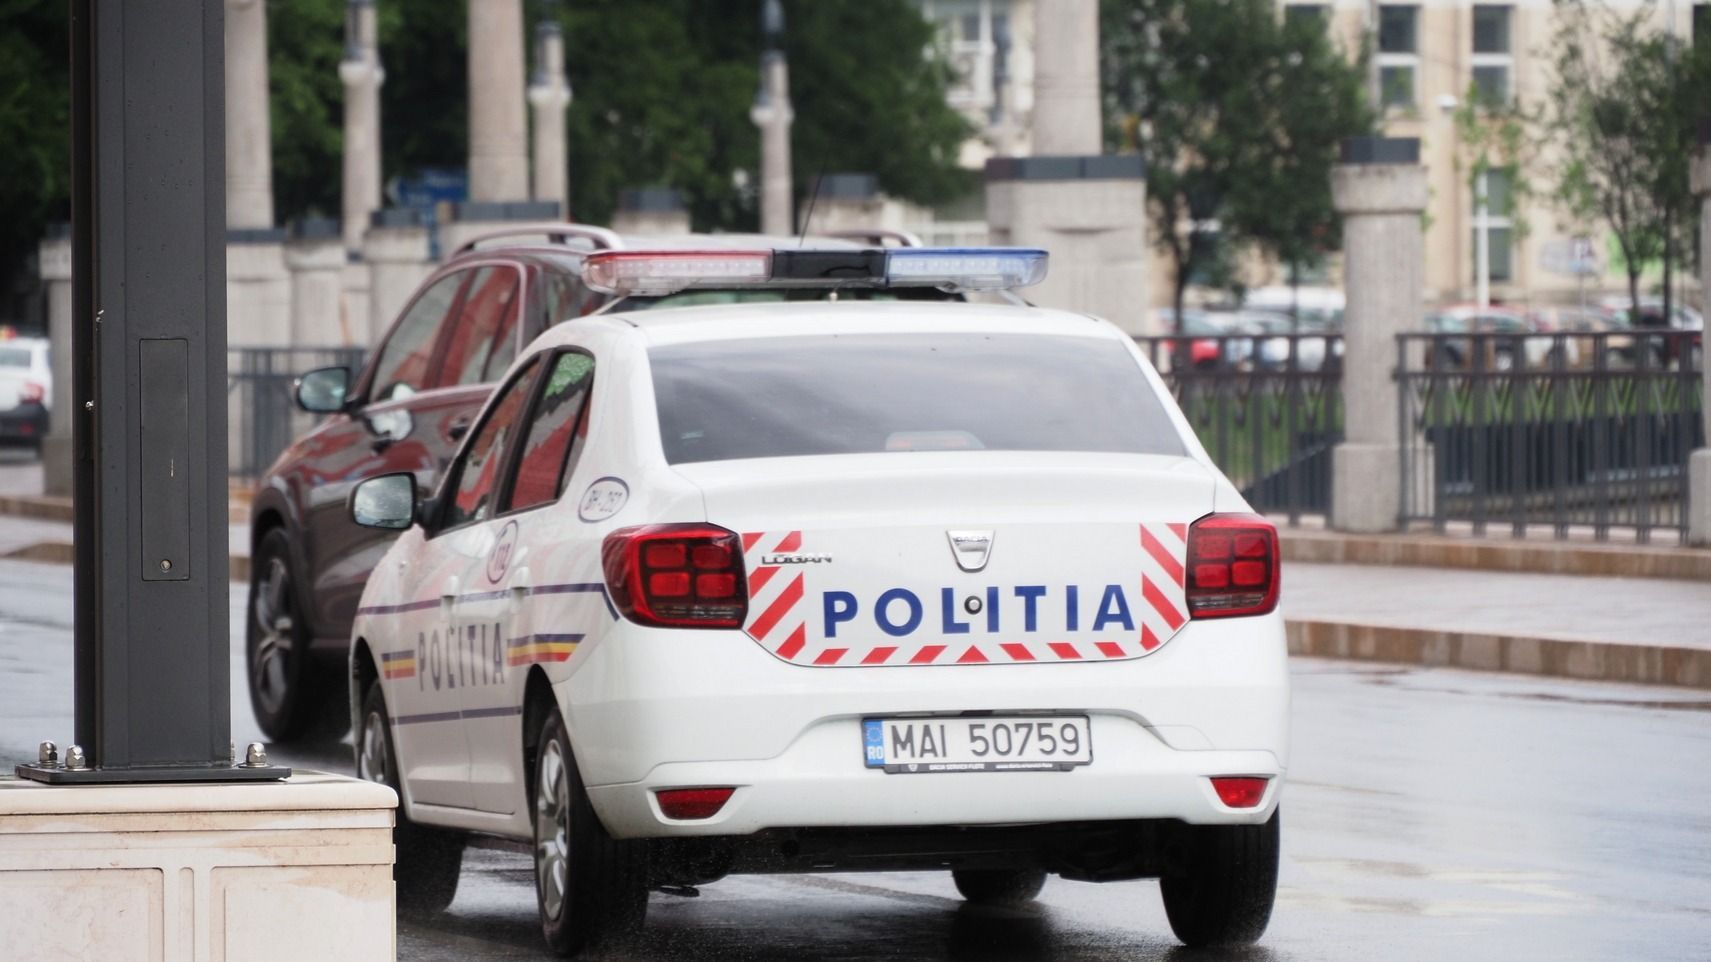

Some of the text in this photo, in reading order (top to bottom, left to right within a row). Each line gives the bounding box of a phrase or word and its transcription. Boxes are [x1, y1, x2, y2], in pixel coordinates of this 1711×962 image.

[761, 553, 833, 565] LOGAN
[822, 584, 1136, 638] POLITIA
[418, 622, 505, 692] POLITIA
[867, 746, 884, 760] RO
[890, 722, 1081, 759] MAI 50759
